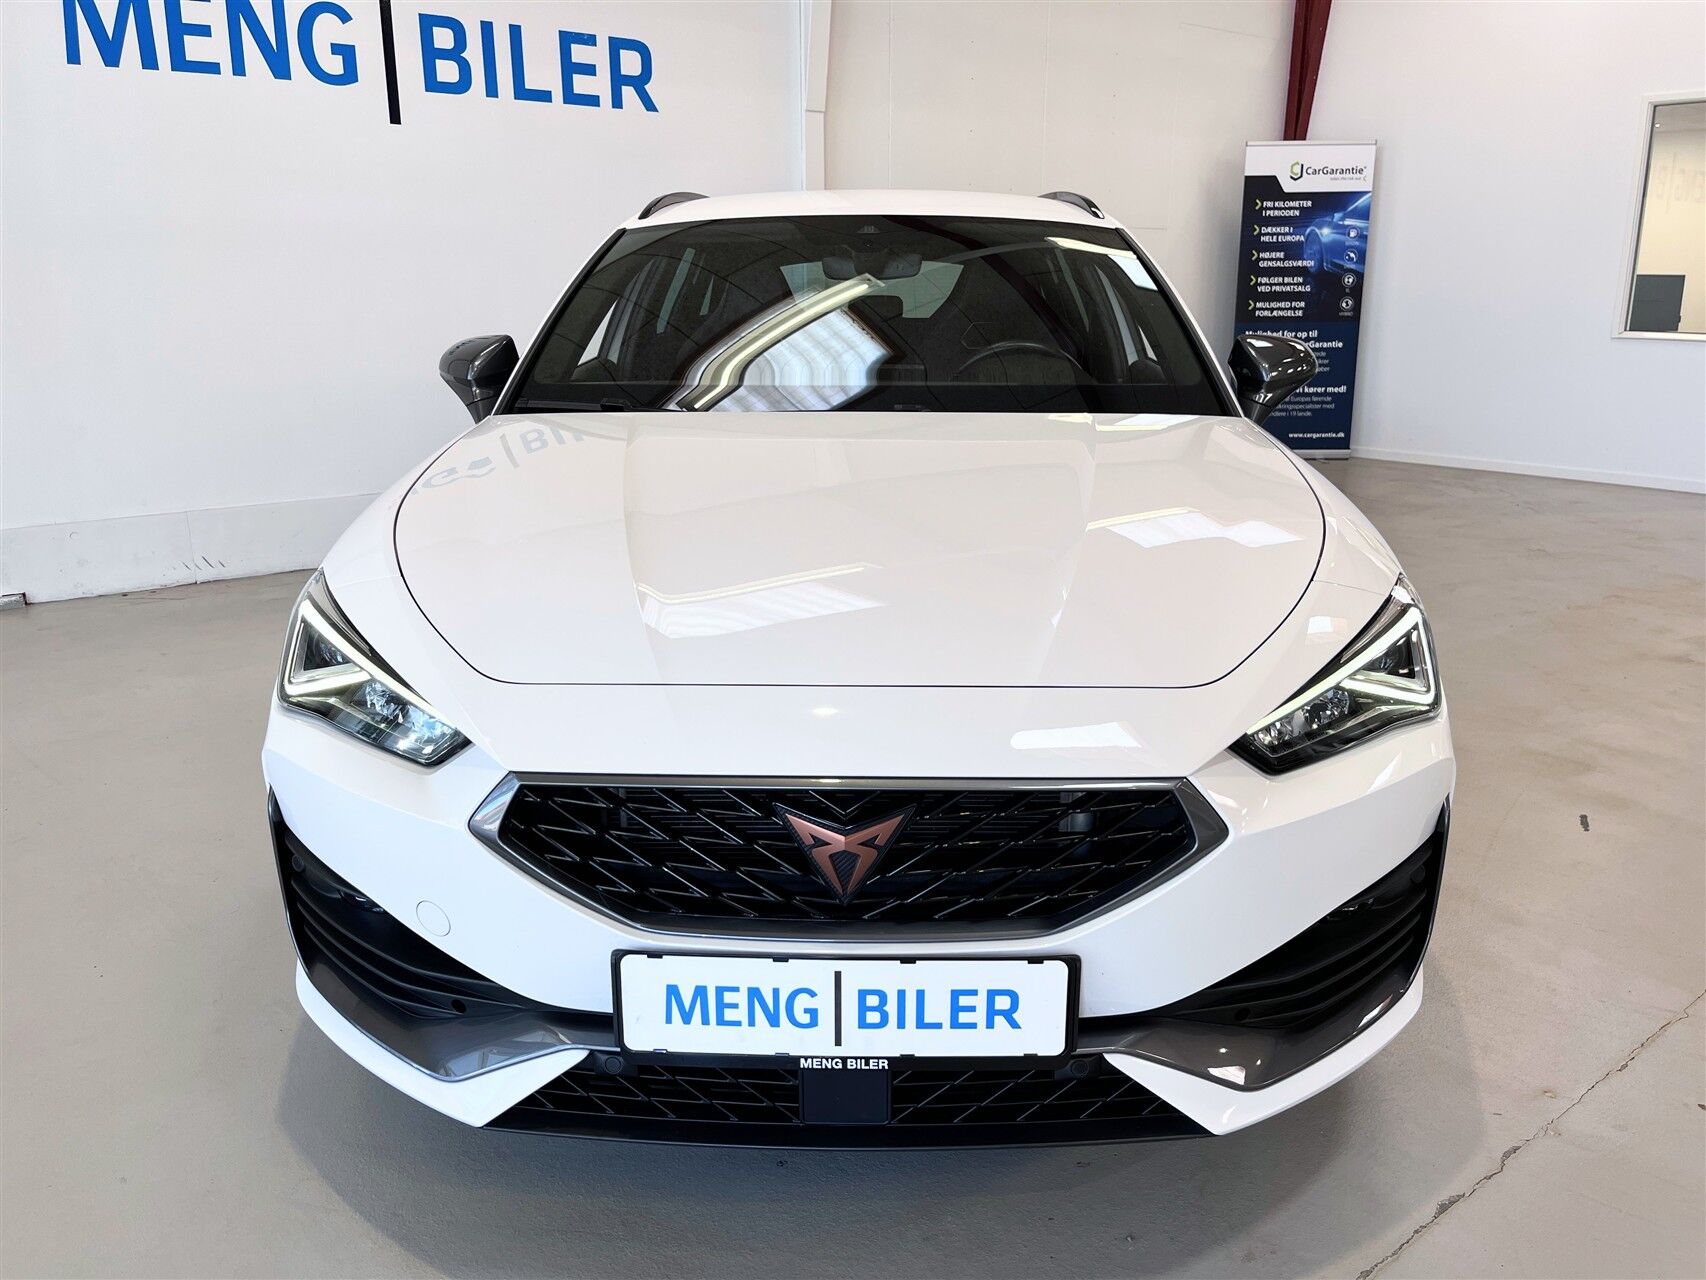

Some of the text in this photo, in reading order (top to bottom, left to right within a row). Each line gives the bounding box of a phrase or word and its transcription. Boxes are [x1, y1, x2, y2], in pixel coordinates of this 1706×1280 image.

[62, 0, 659, 113] MENG BILER
[1305, 166, 1364, 176] CarGarantie
[665, 984, 1022, 1030] MENG BILER
[800, 1058, 889, 1070] MENG BILER
